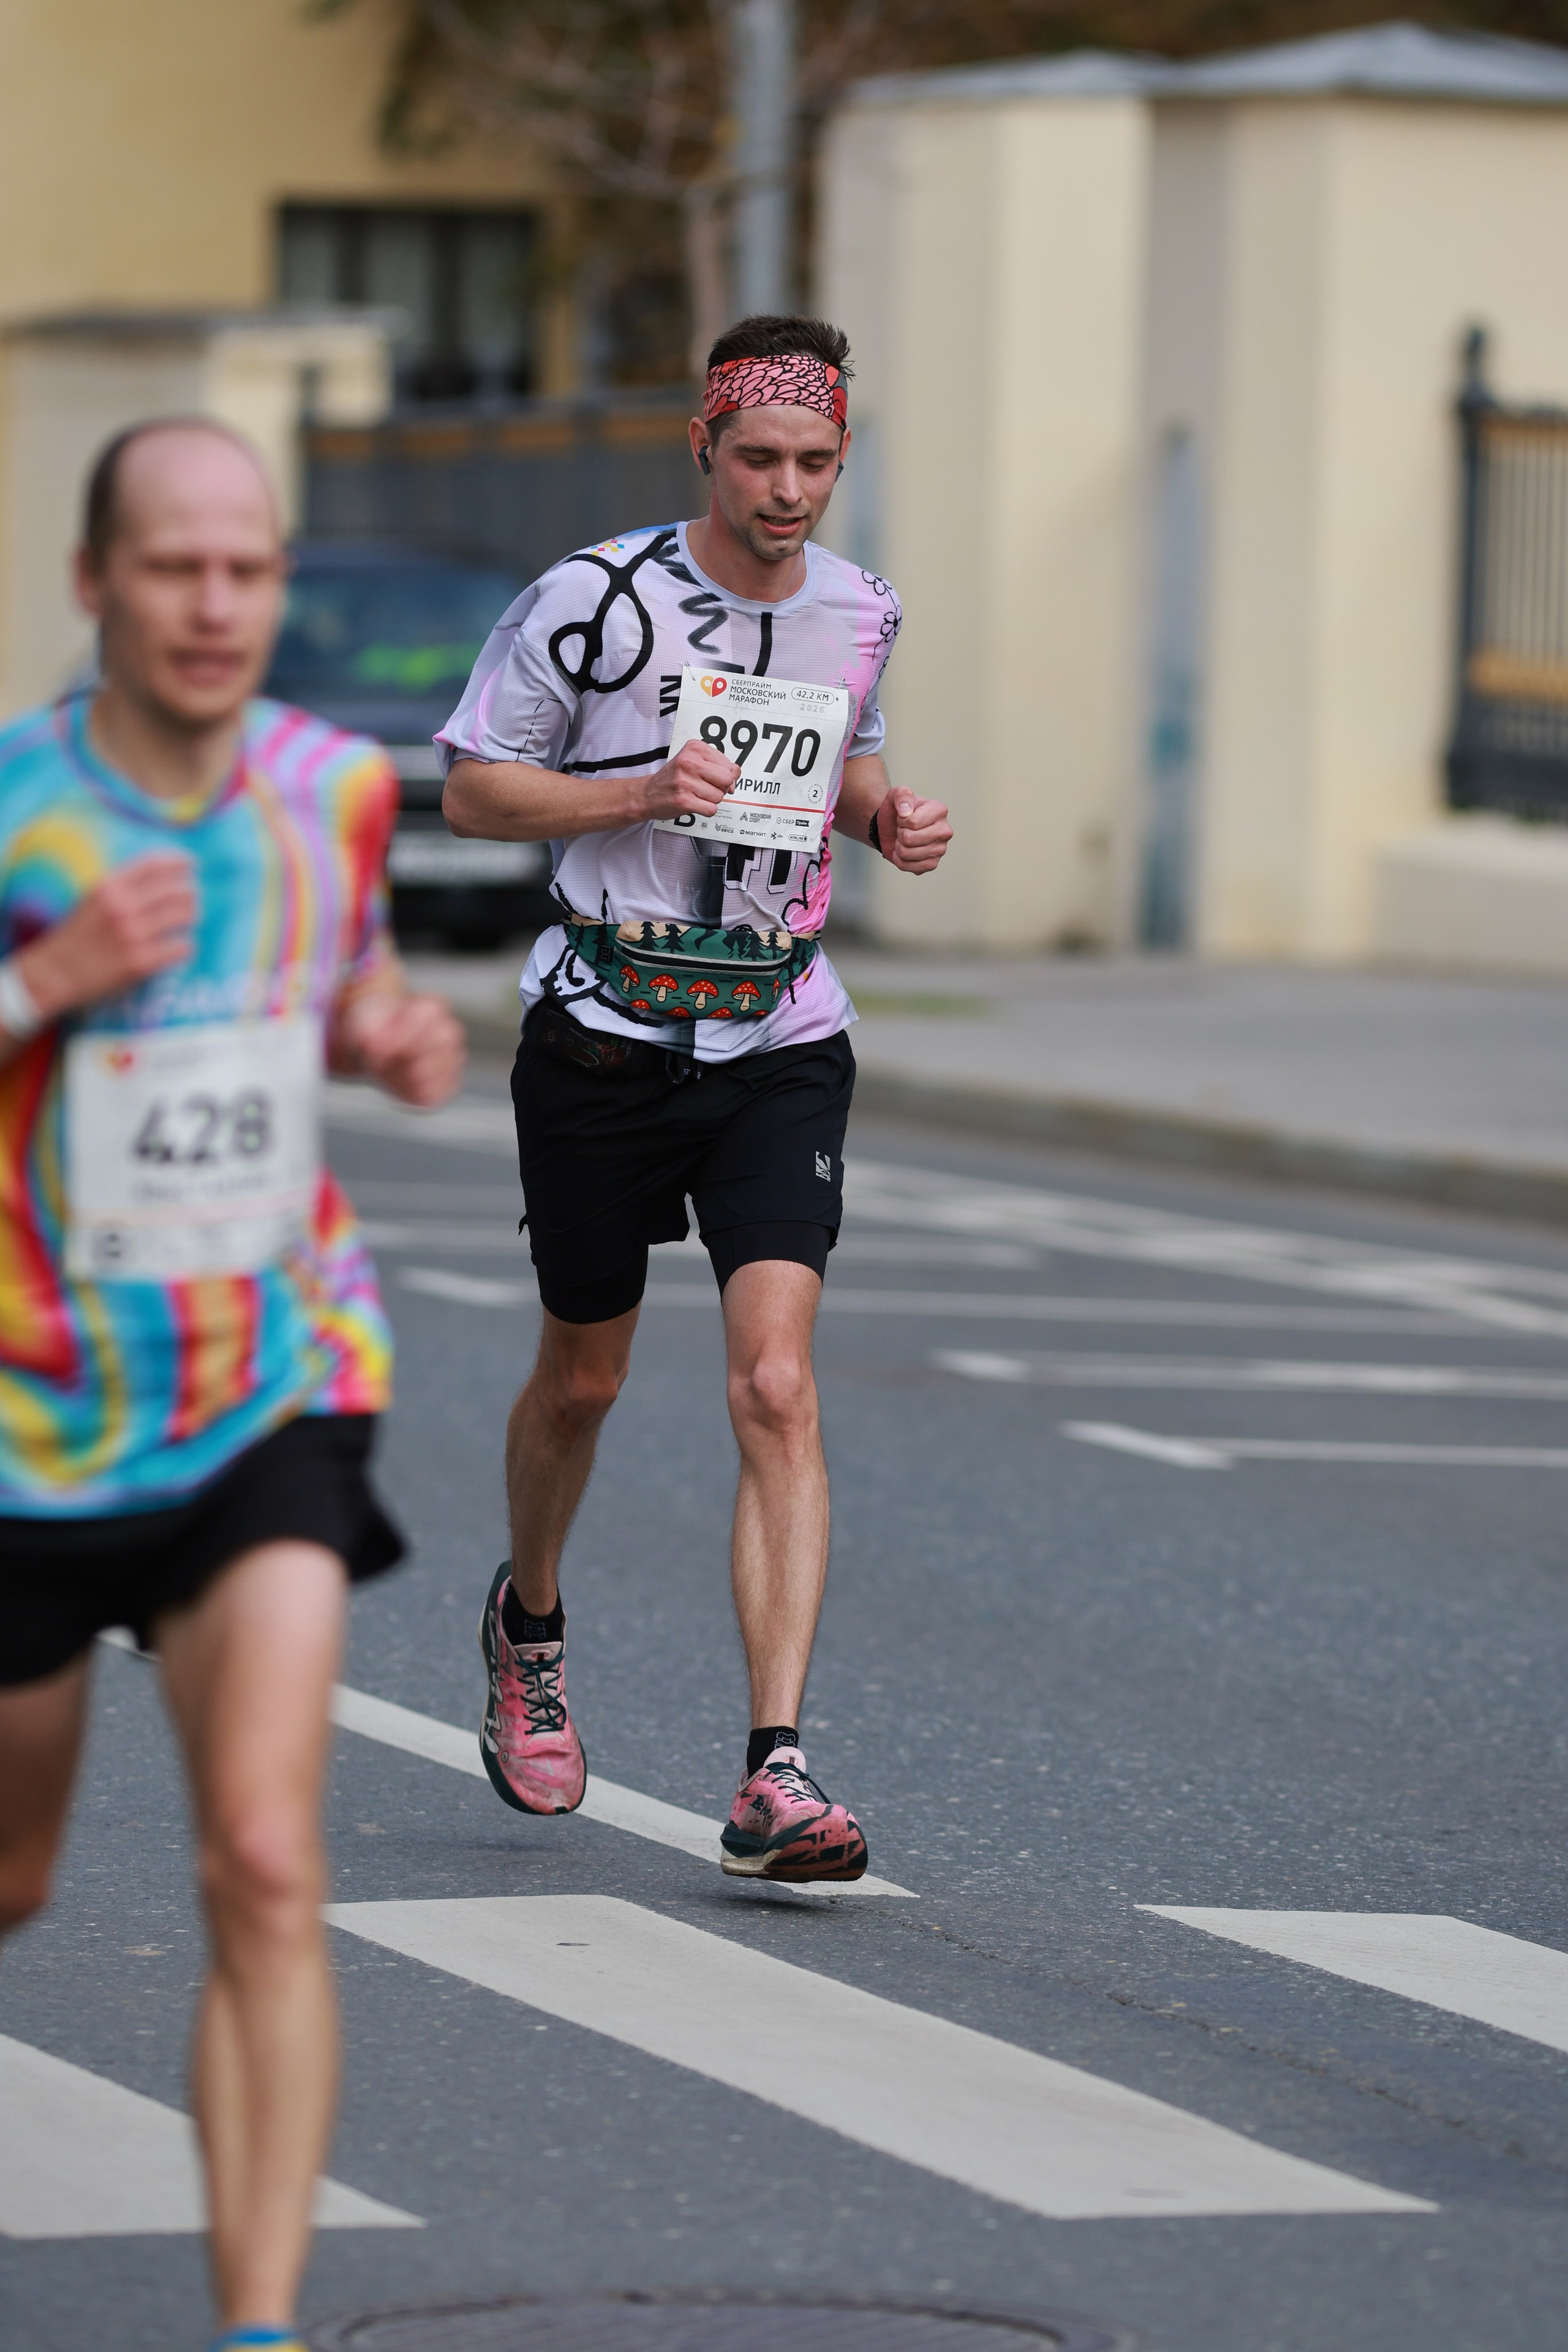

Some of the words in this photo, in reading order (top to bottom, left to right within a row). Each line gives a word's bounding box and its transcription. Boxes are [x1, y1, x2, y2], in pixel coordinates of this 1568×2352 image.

[731, 679, 772, 689] СБЕРПРАЙМ
[730, 686, 786, 699] МОСКОВСКИЙ
[796, 690, 813, 699] 42,2
[729, 695, 769, 705] МАРАФОН
[699, 715, 821, 777] 8970
[735, 778, 780, 794] ИРИЛЛ
[132, 1092, 274, 1163] 428
